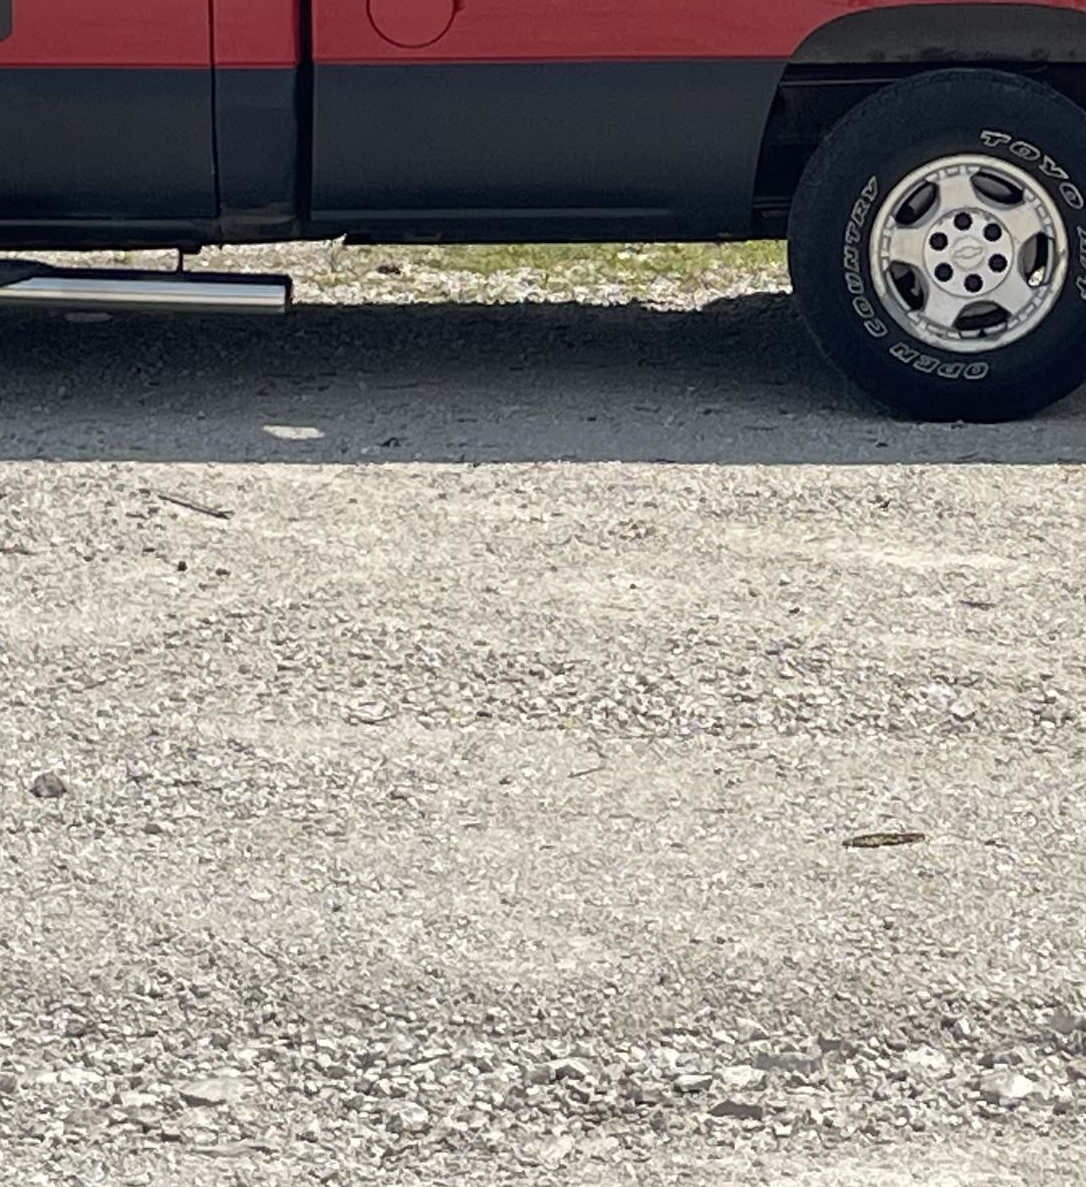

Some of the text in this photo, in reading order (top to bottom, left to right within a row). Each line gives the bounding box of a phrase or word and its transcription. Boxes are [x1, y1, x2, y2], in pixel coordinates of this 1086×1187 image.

[979, 129, 1085, 210] TOYO
[843, 175, 990, 380] OPEN COUNTRY
